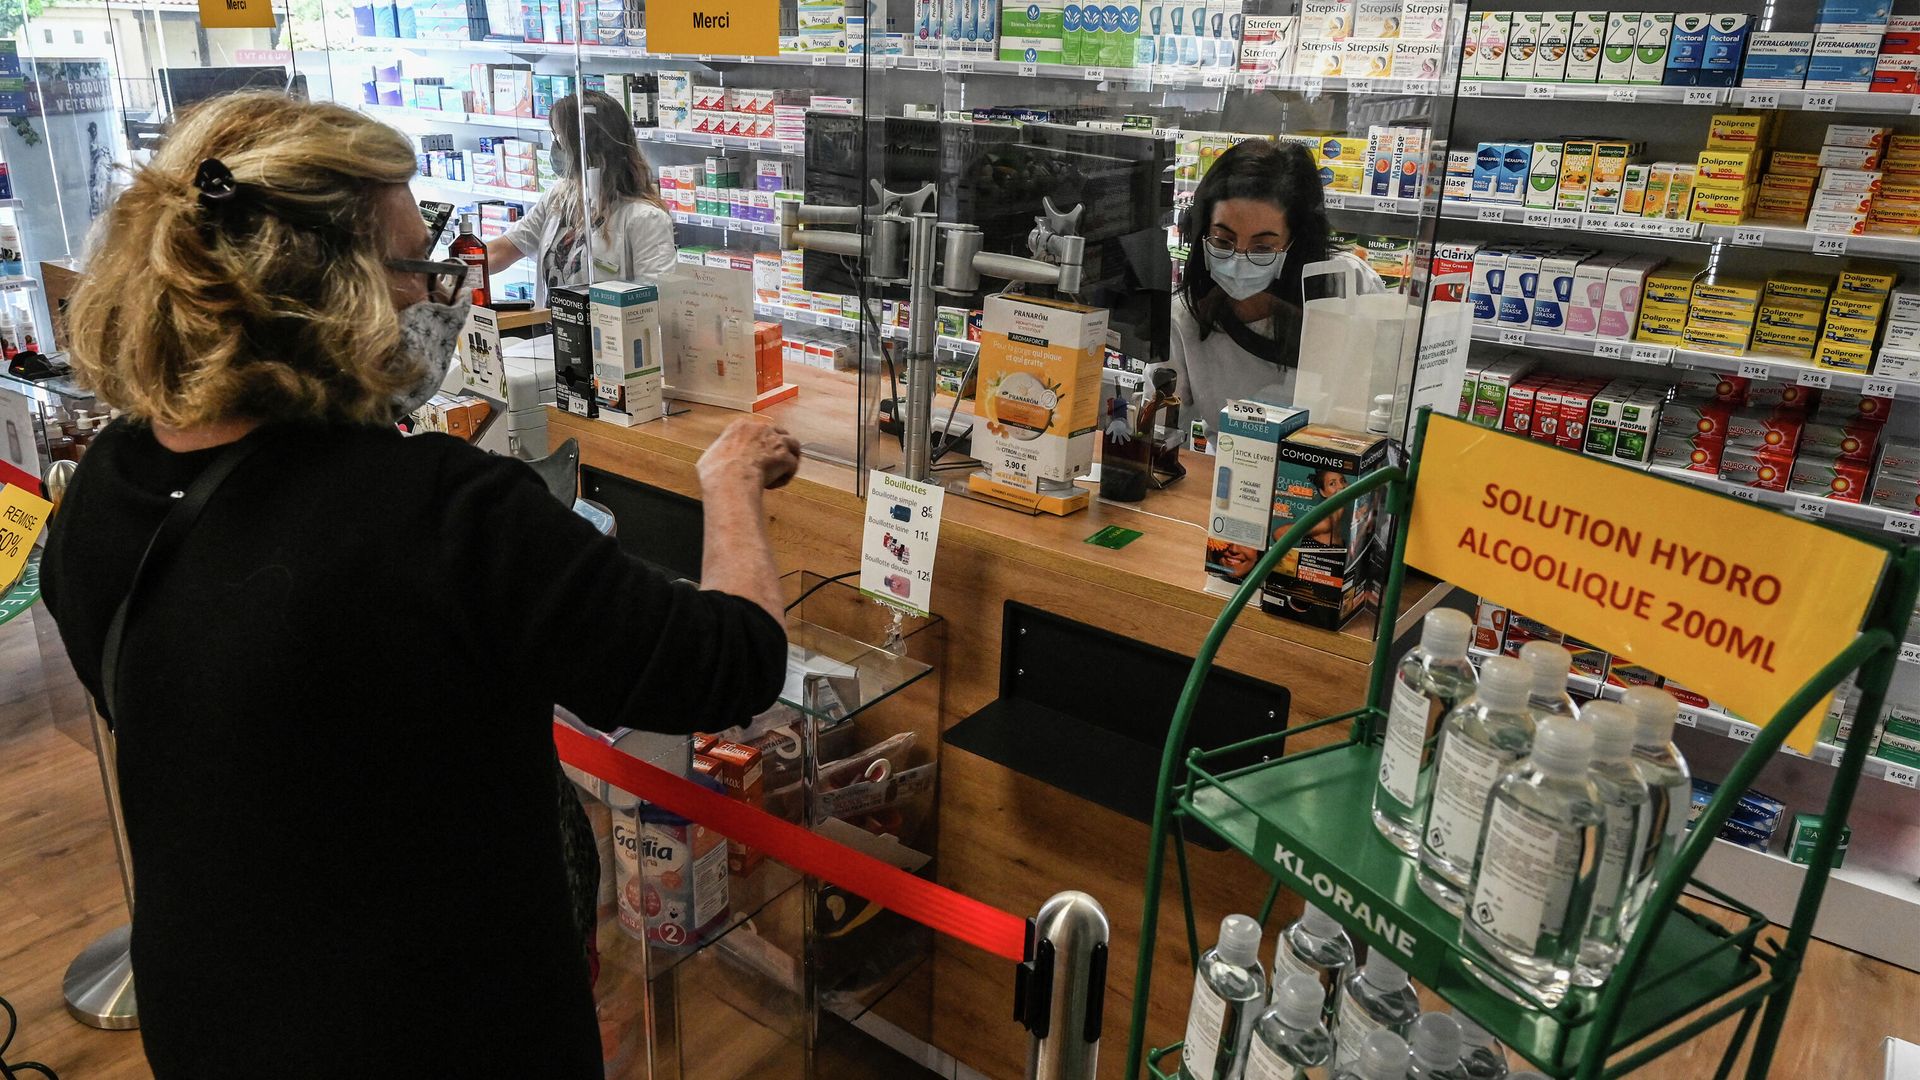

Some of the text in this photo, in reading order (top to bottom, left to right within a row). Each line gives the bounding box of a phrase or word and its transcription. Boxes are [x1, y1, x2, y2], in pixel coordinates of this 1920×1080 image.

[226, 0, 247, 10] Merci
[1306, 3, 1347, 14] Strepsils
[1360, 3, 1402, 14] Strepsils
[693, 12, 730, 29] Merci
[1248, 19, 1282, 30] Strefen
[1675, 34, 1704, 43] Pectoral
[1710, 35, 1740, 43] Pectoral
[1752, 40, 1809, 48] EFFERALGANMED
[1302, 42, 1342, 52] Strepsils
[1347, 42, 1389, 53] Strepsils
[1397, 43, 1440, 54] Strepsils
[1817, 41, 1876, 49] EFFERALGANMED
[1243, 48, 1277, 58] Strefen
[659, 74, 686, 82] Microbiosys
[659, 104, 686, 112] Microbiosys
[1714, 119, 1755, 128] Doliprane
[1365, 134, 1378, 177] Maxilase
[1391, 135, 1405, 180] Maxilase
[1774, 153, 1806, 161] Doliprane
[1701, 157, 1743, 167] Doliprane
[1883, 160, 1915, 169] Doliprane
[1765, 175, 1796, 183] Doliprane
[1698, 192, 1739, 202] Doliprane
[1871, 209, 1905, 217] Doliprane
[1738, 233, 1755, 241] 2,18
[1368, 240, 1395, 249] HUMER
[1819, 240, 1836, 249] 2,18
[1442, 249, 1474, 261] Clarix
[1844, 274, 1885, 284] Doliprane
[1648, 281, 1687, 291] Doliprane
[1695, 284, 1726, 294] Doliprane
[1768, 282, 1808, 293] Doliprane
[551, 296, 584, 310] COMODYNES
[1831, 299, 1872, 310] Doliprane
[1013, 309, 1049, 321] PRANARÔM
[1501, 307, 1522, 315] GRASSE
[1535, 311, 1556, 319] GRASSE
[1692, 306, 1723, 315] Doliprane
[1762, 307, 1804, 318] Doliprane
[1642, 313, 1681, 323] Doliprane
[1685, 328, 1715, 338] Doliprane
[1827, 324, 1868, 334] Doliprane
[1011, 334, 1044, 346] AROMAFORCE
[1756, 330, 1796, 341] Doliprane
[1032, 349, 1043, 358] qui
[1043, 351, 1063, 362] pique
[1421, 349, 1446, 361] PARTENAIRE
[1823, 348, 1864, 359] Doliprane
[1012, 355, 1023, 364] qui
[1023, 358, 1044, 368] gratte
[1744, 366, 1759, 374] 2,18
[602, 385, 613, 395] 5,50
[1869, 384, 1886, 392] 2,18
[1008, 393, 1039, 406] PRANARÔM
[1234, 404, 1263, 415] 5,50 €
[1228, 419, 1270, 434] LA ROSÉE
[1590, 417, 1617, 426] PROSPAN
[1620, 421, 1647, 431] PROSPAN
[1728, 425, 1765, 437] NUROFEN
[1001, 447, 1017, 456] CITRON
[1235, 449, 1274, 463] STICK LÈVRES
[1282, 448, 1343, 469] COMODYNES
[1360, 448, 1384, 469] COMODYNES
[1004, 460, 1026, 472] 3,90 €
[1723, 461, 1758, 472] NUROFEN
[884, 475, 927, 496] Bouillottes
[1277, 482, 1288, 490] DU
[1278, 476, 1310, 488] QUI VEUT
[871, 487, 917, 508] Bouillotte simple
[1801, 503, 1817, 511] 4,95
[3, 505, 38, 531] REMISE
[868, 515, 895, 530] Bouillotte
[1890, 519, 1908, 528] 4,95
[1482, 482, 1782, 607] SOLUTION HYDRO
[864, 553, 913, 576] Bouillotte douceur
[1457, 526, 1776, 674] ALCOOLIQUE 200ML
[1734, 729, 1749, 738] 3,67
[1890, 740, 1916, 751] ASPIRINE
[1890, 771, 1907, 780] 4,60
[1273, 842, 1417, 959] KLORANE
[665, 925, 679, 943] 2
